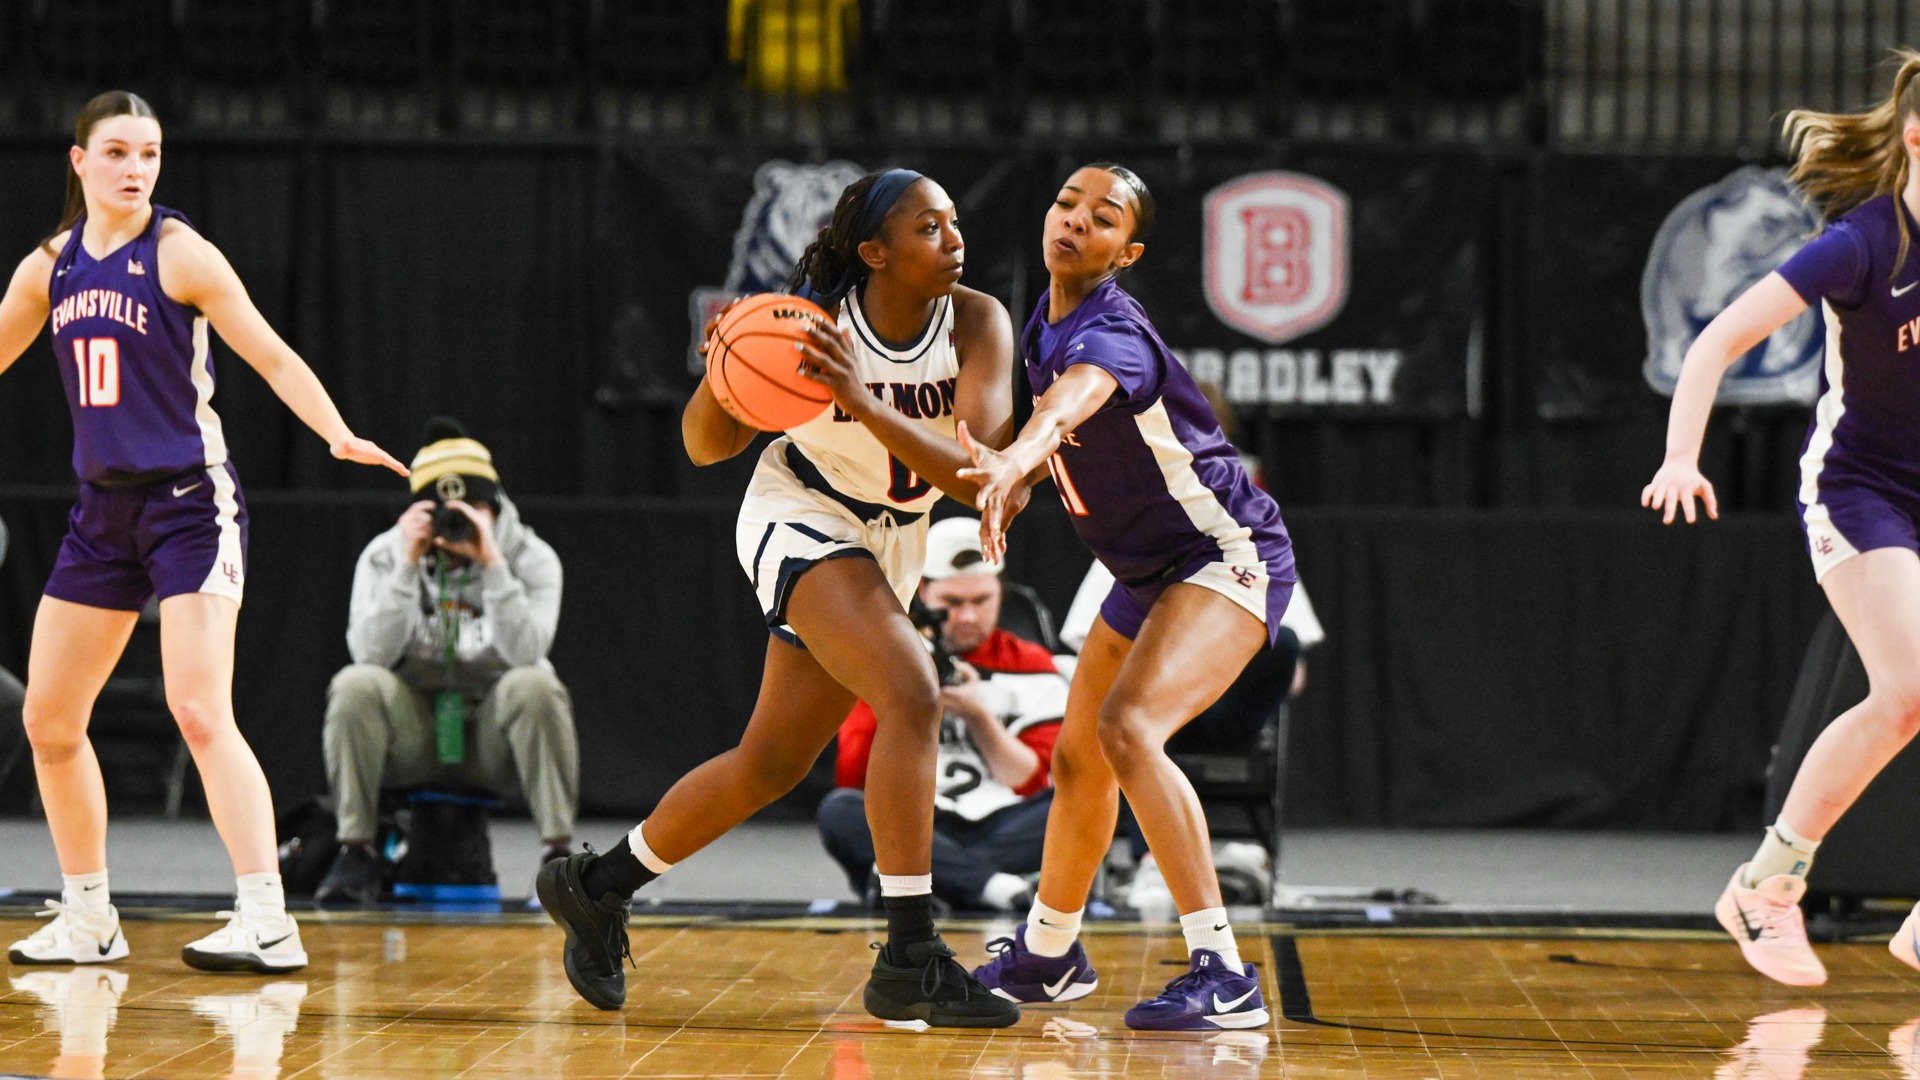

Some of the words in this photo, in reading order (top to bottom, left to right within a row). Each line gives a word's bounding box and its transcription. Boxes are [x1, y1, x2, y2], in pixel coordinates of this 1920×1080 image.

[52, 289, 148, 336] EVANSVILLE
[72, 337, 121, 408] 10
[1172, 350, 1400, 404] RADLEY
[941, 761, 982, 802] 2
